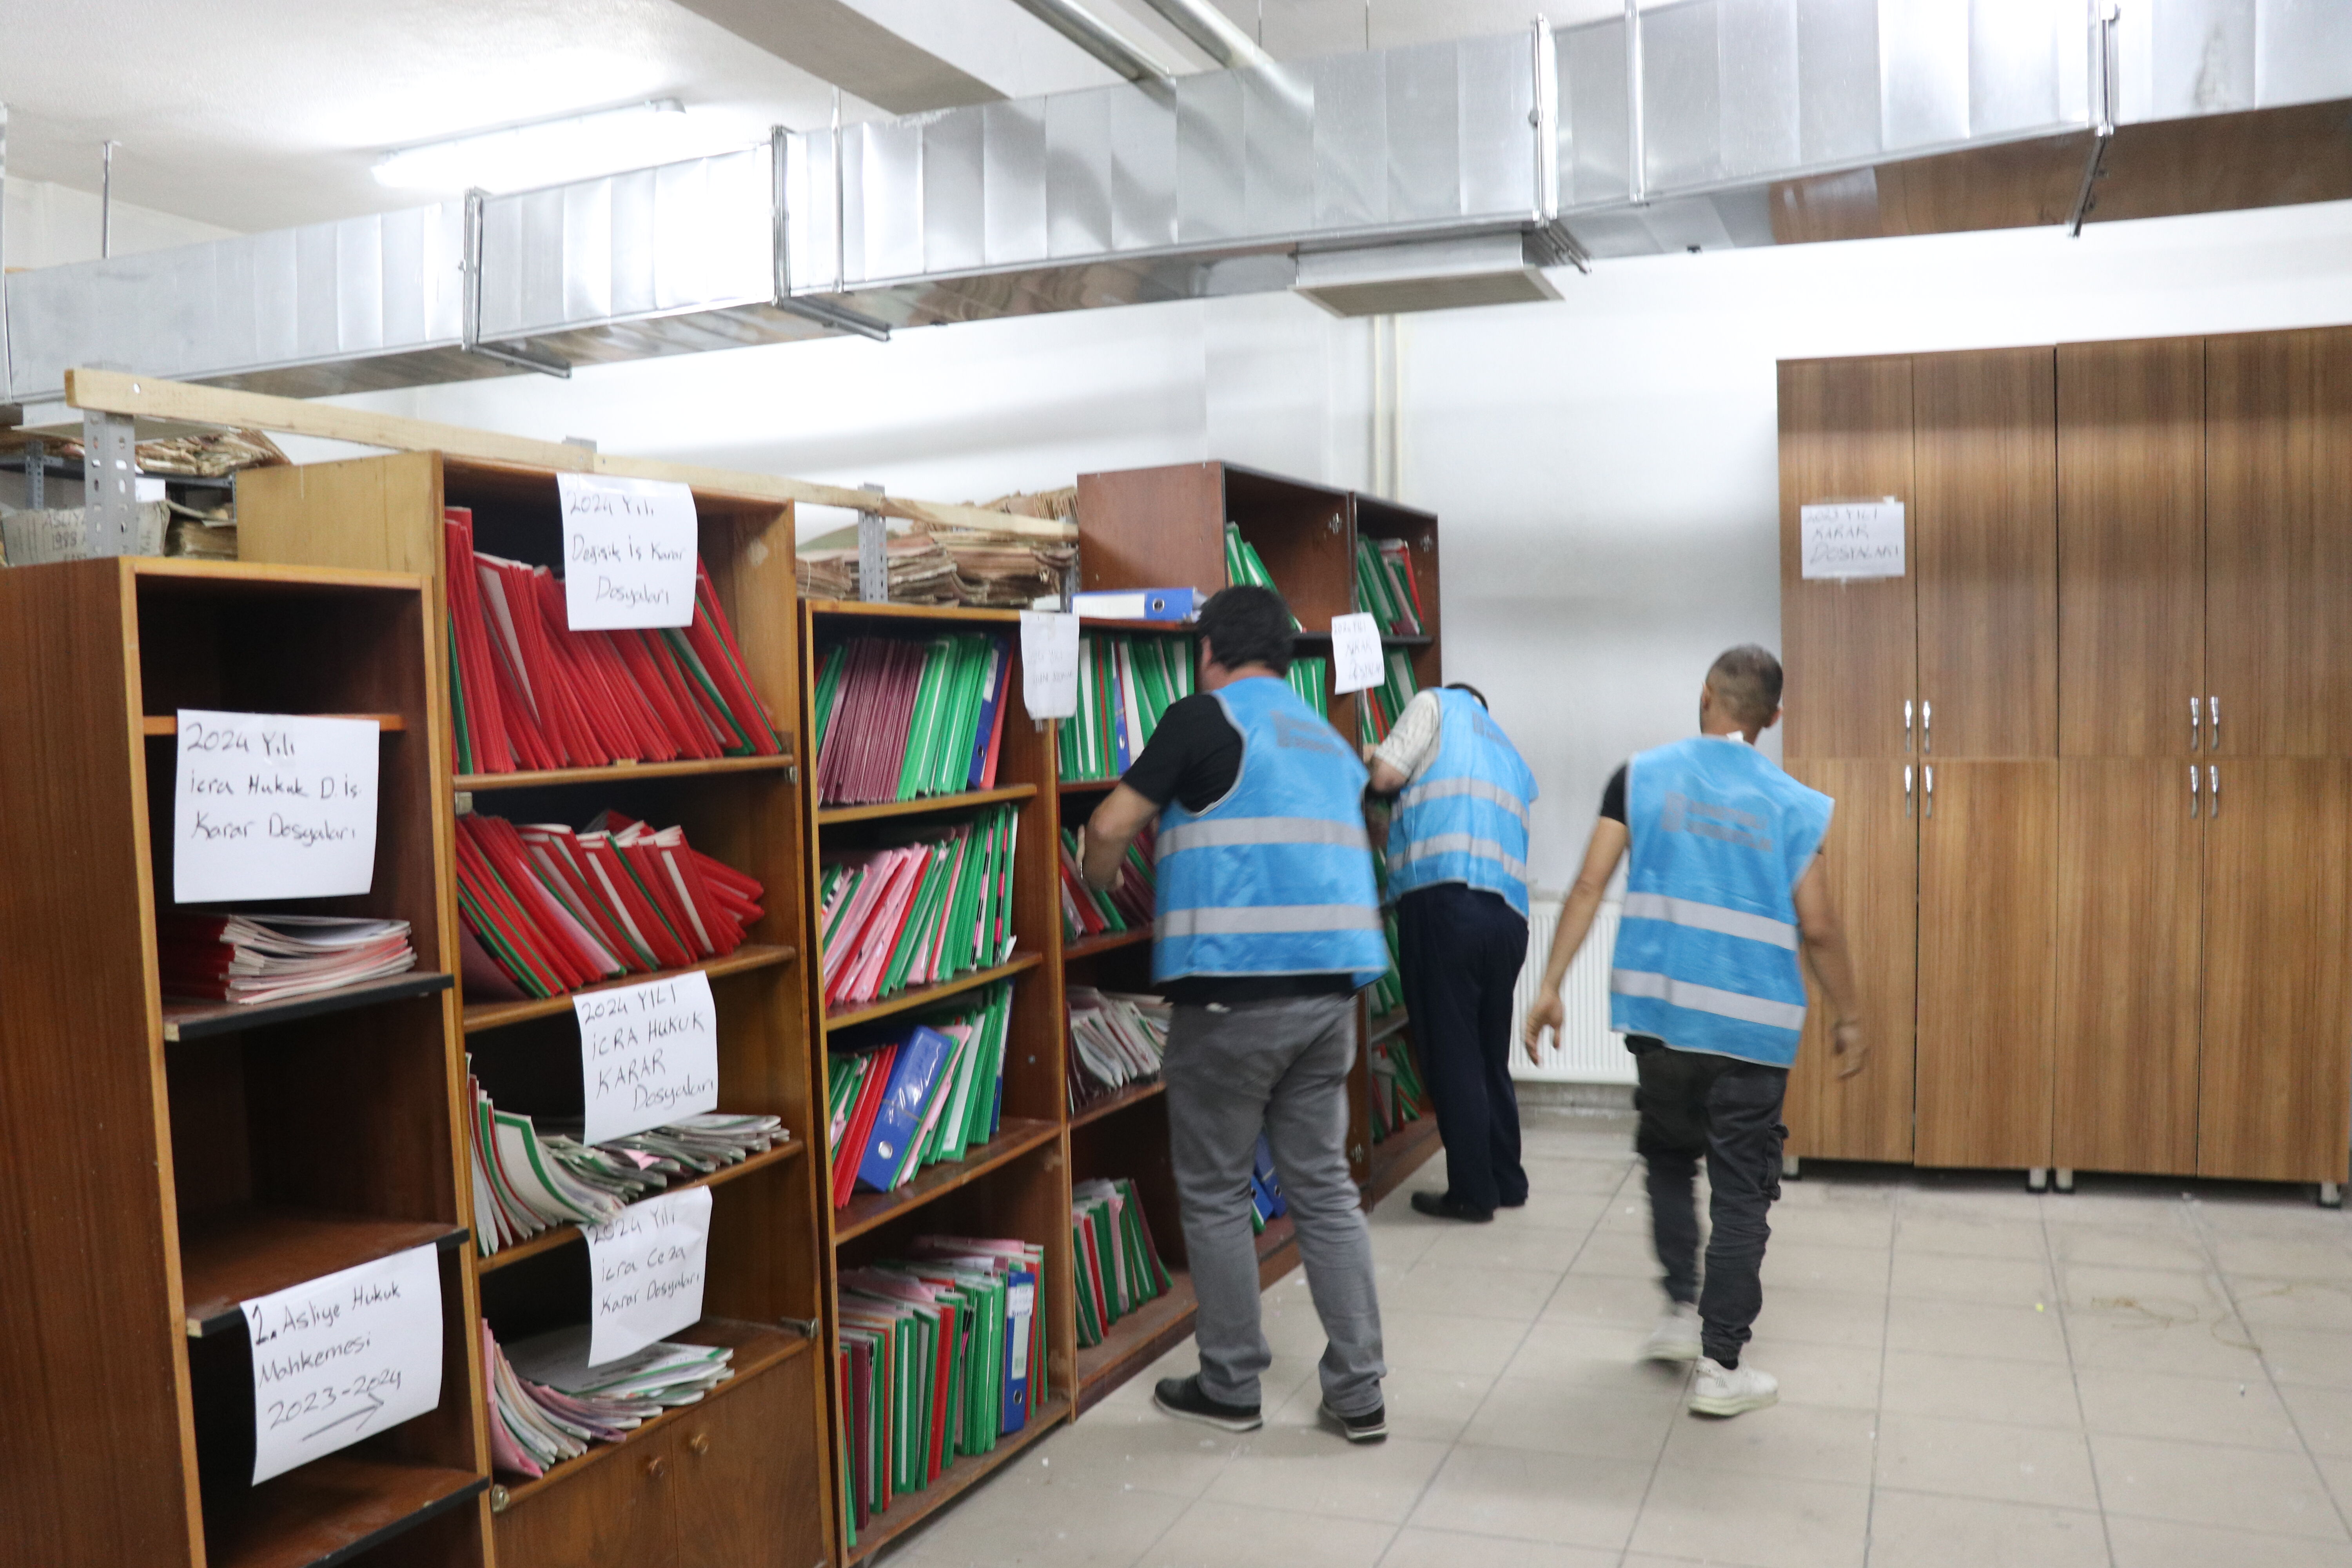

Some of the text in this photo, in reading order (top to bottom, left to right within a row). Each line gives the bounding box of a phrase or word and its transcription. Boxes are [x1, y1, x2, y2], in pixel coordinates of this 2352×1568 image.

[567, 491, 613, 515] 2024
[1812, 523, 1869, 542] KARAR
[651, 541, 686, 562] Karar
[1809, 541, 1898, 564] DOSYALARI
[596, 575, 669, 608] Dosyaları
[186, 722, 249, 752] 2024
[248, 774, 310, 798] Hukuk
[191, 810, 356, 847] Karar Dosyaları
[582, 983, 676, 1025] 2024 YILI
[648, 1010, 705, 1044] HUKUK
[596, 1048, 666, 1100] KARAR
[633, 1073, 714, 1112] Dosyaları
[588, 1216, 642, 1246] 2024
[646, 1245, 687, 1268] Ceza
[283, 1299, 341, 1334] Asliye
[352, 1280, 402, 1310] Hukuk
[599, 1272, 700, 1317] Karar Dosyaları
[259, 1330, 372, 1390] Mahkemesi
[267, 1367, 403, 1431] 2023-2024
